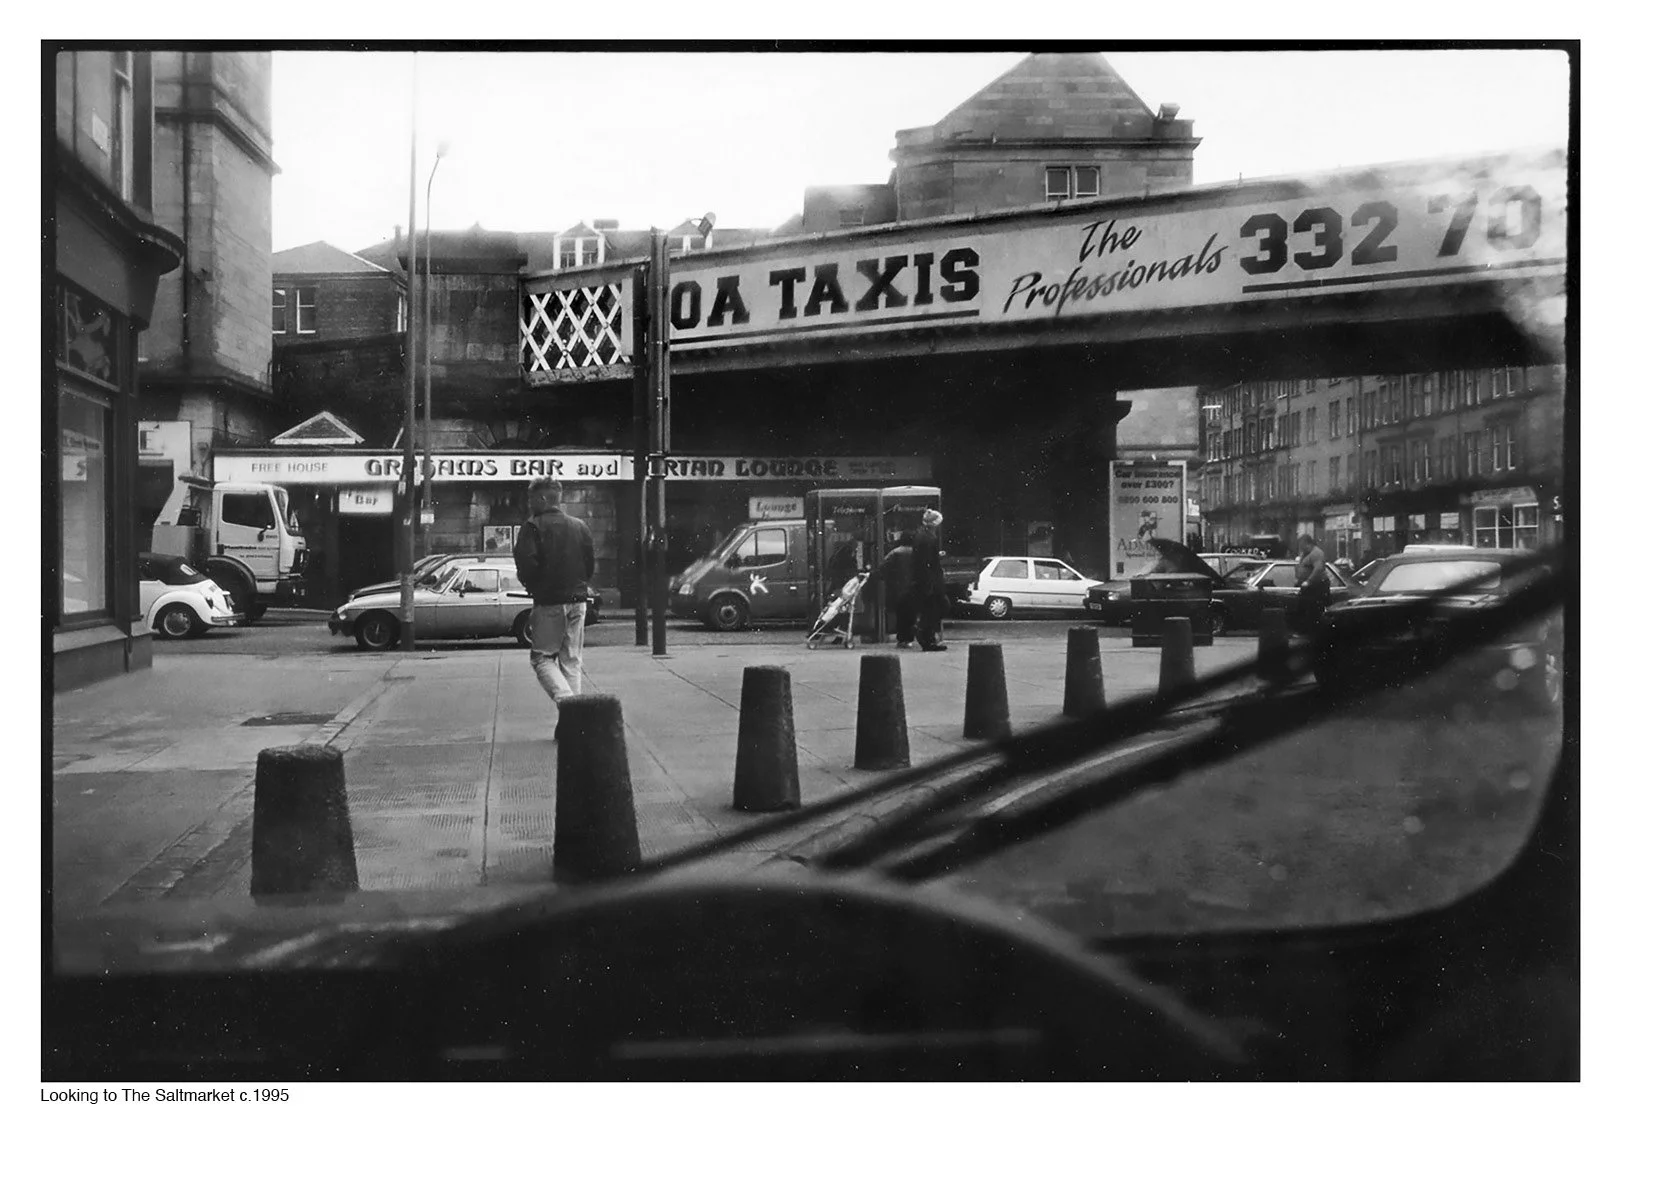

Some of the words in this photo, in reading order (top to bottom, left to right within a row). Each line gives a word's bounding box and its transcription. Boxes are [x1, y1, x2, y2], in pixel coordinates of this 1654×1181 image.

[1079, 218, 1143, 264] The
[1239, 200, 1399, 275] 332
[670, 274, 751, 331] OA
[769, 246, 981, 320] TAXIS
[1002, 232, 1229, 316] Professionals
[251, 461, 282, 474] FREE
[287, 461, 329, 474] HOUSE
[510, 458, 564, 476] BAR
[576, 458, 619, 480] and
[735, 458, 839, 477] LOUNGE
[756, 501, 799, 514] Lounge
